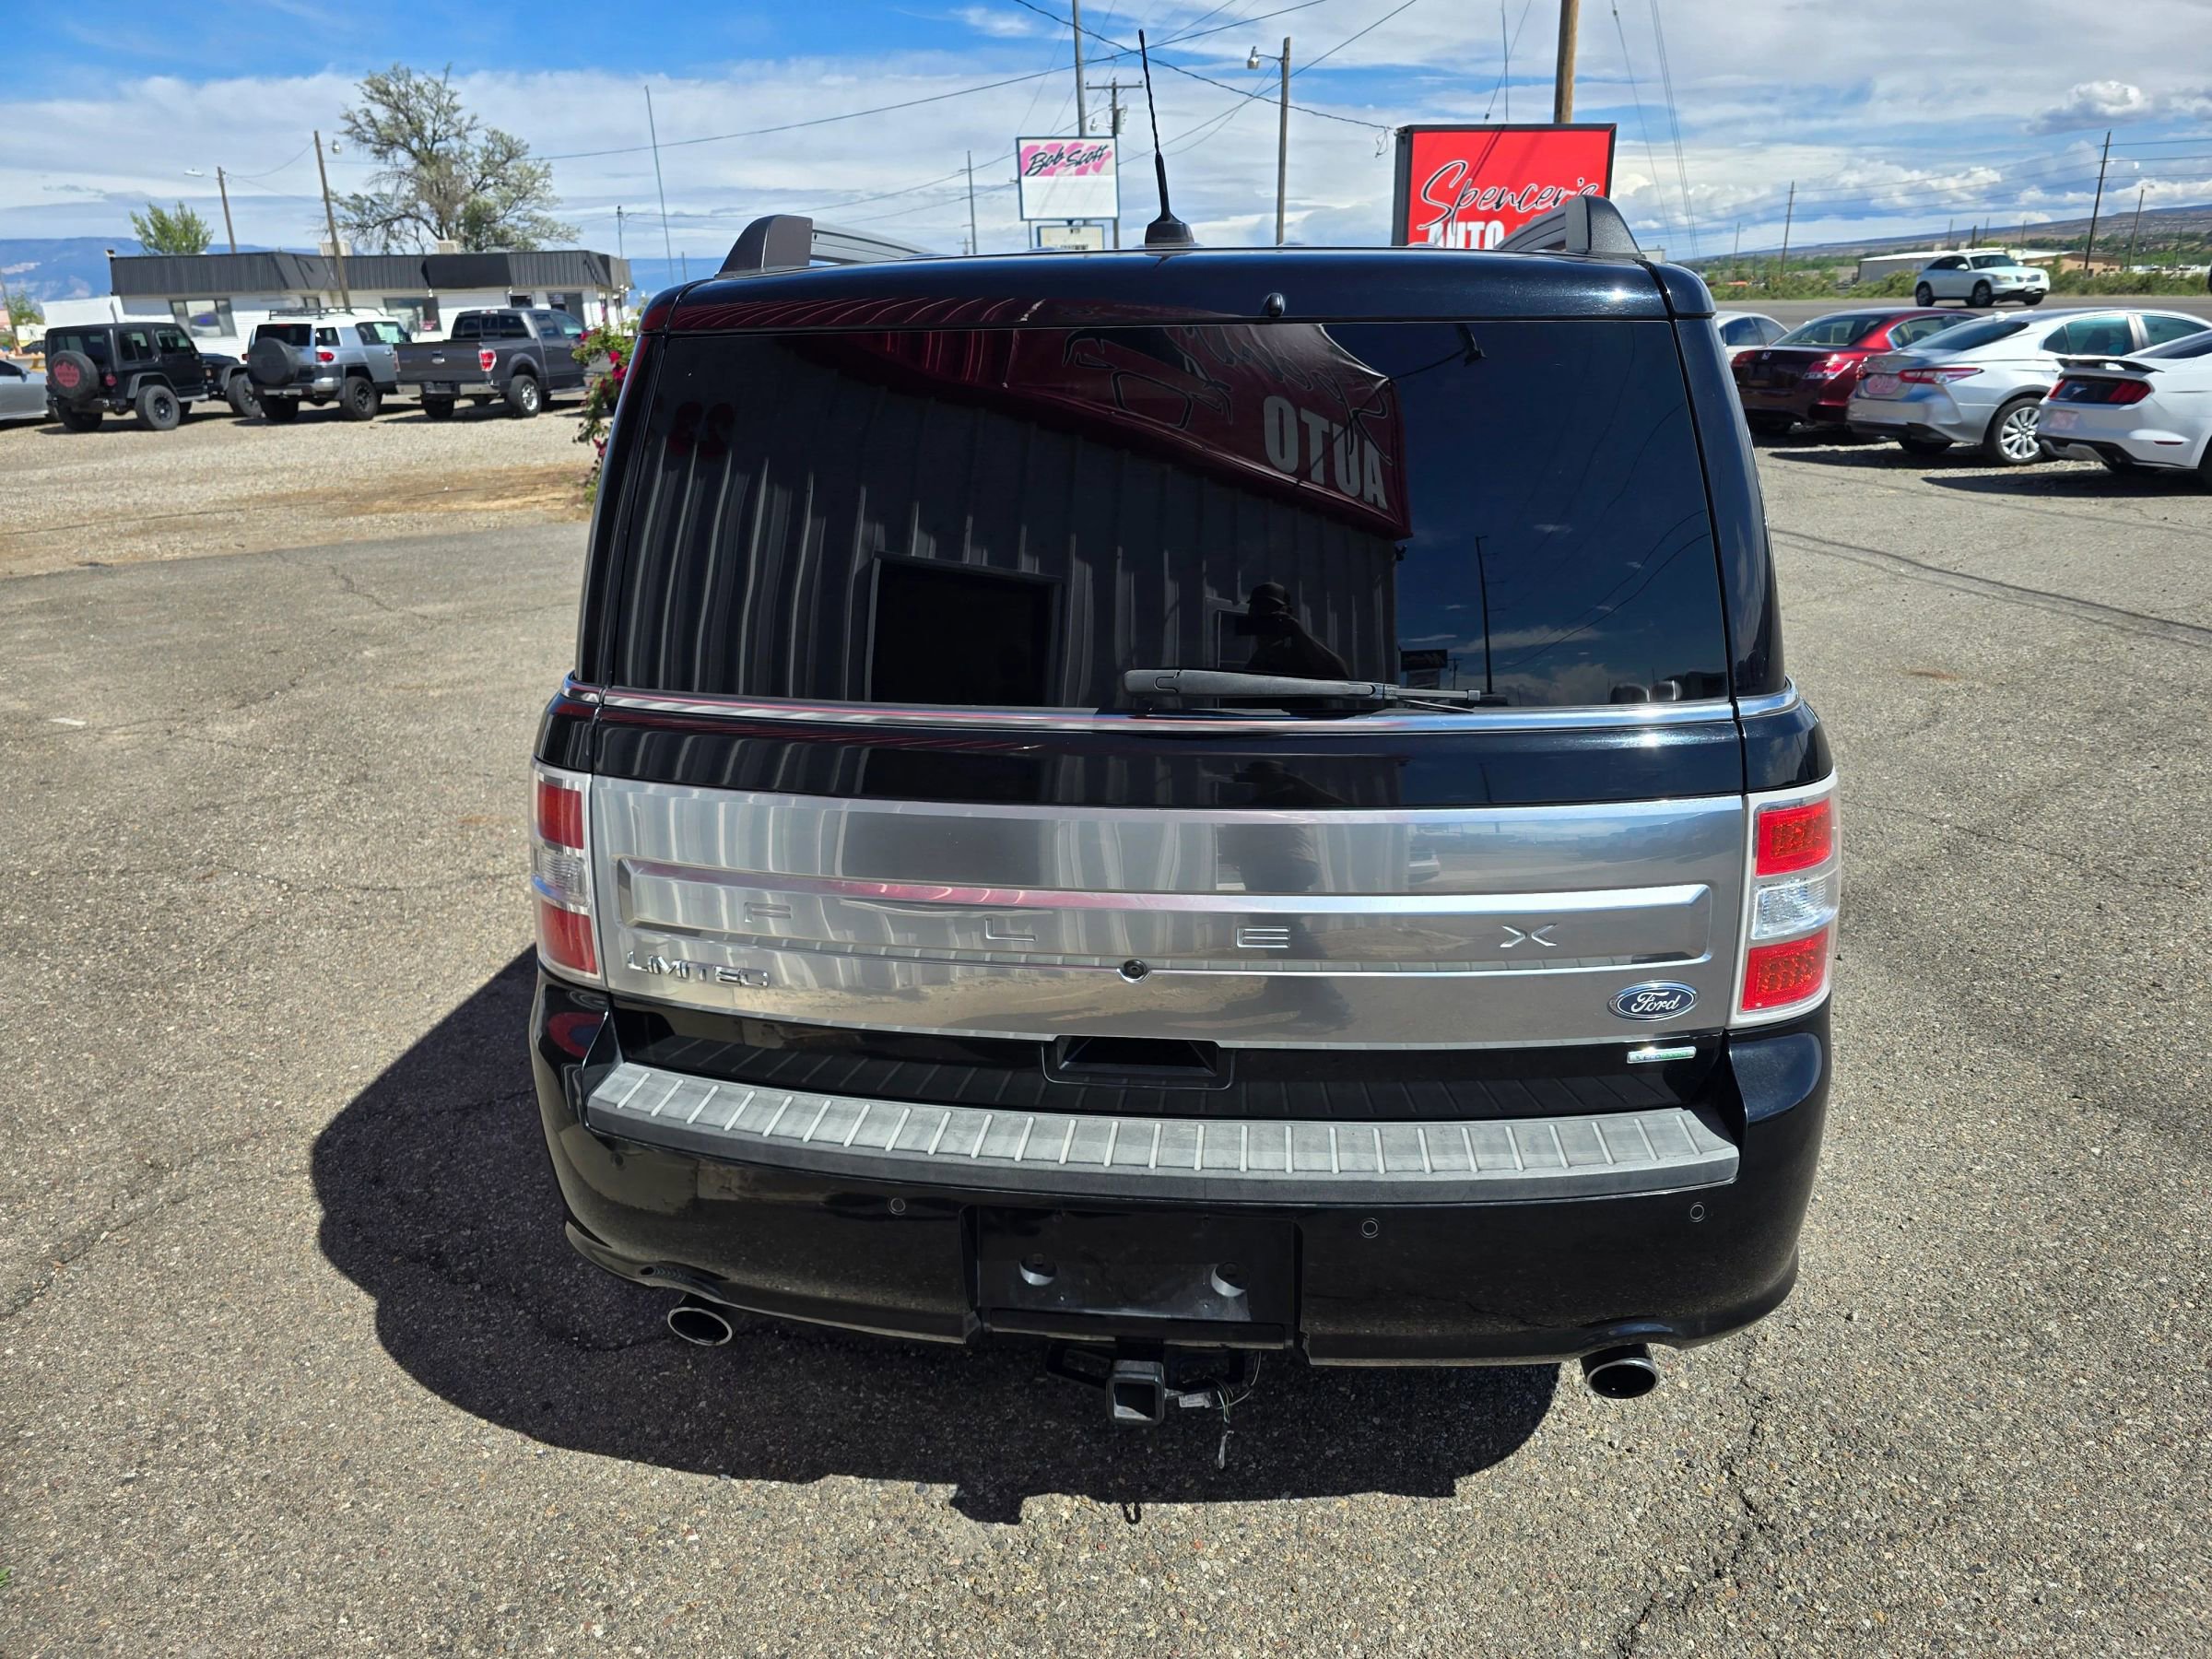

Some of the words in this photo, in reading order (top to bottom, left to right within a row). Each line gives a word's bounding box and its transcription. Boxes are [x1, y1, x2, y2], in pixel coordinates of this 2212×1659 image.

[1025, 146, 1064, 176] Bob
[1065, 144, 1109, 168] Scott
[1417, 159, 1599, 235] Spencer's
[1428, 220, 1504, 249] AUTO
[744, 901, 1558, 948] FLEX
[627, 950, 771, 987] LIMITED
[1630, 991, 1681, 1013] Ford
